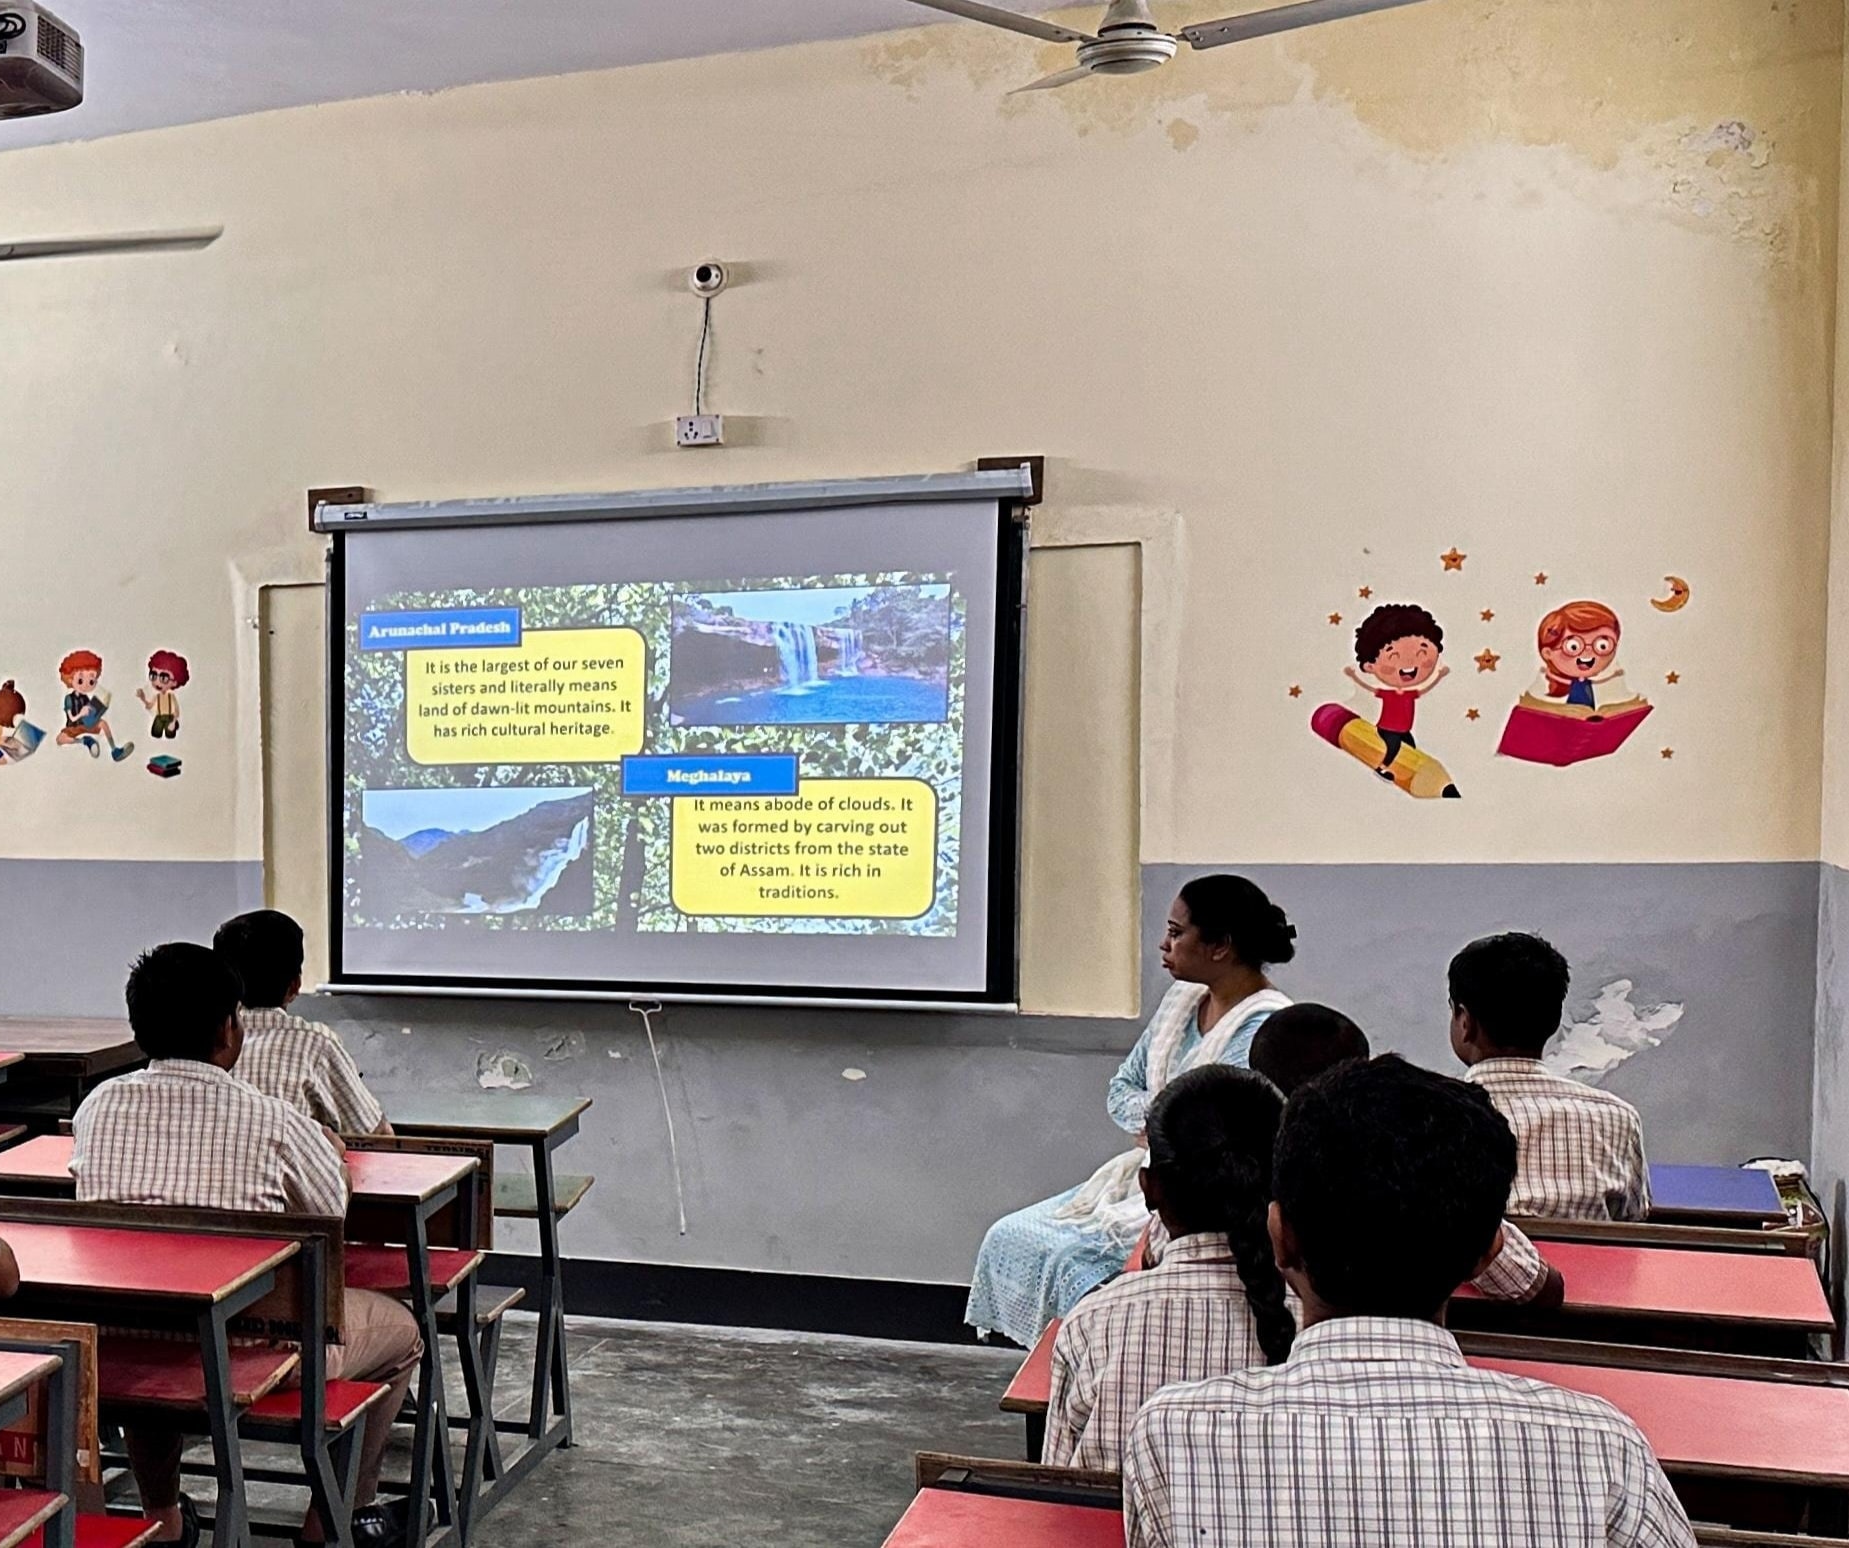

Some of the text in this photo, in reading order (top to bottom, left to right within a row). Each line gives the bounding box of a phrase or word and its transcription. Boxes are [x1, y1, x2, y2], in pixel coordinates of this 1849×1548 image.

[368, 622, 510, 639] Arunachal Pradesh
[426, 658, 624, 674] It is the largest of our seven
[432, 680, 617, 695] sisters and literally means
[419, 701, 631, 717] land of dawn-lit mountains. It
[434, 722, 614, 737] has rich cultural heritage.
[667, 770, 751, 784] Meghalaya
[694, 797, 913, 811] It means abode of clouds. It
[698, 820, 907, 836] was formed by carving out
[695, 842, 909, 856] two districts from the state
[720, 864, 881, 877] of Assam. It is rich in
[759, 886, 839, 899] traditions.
